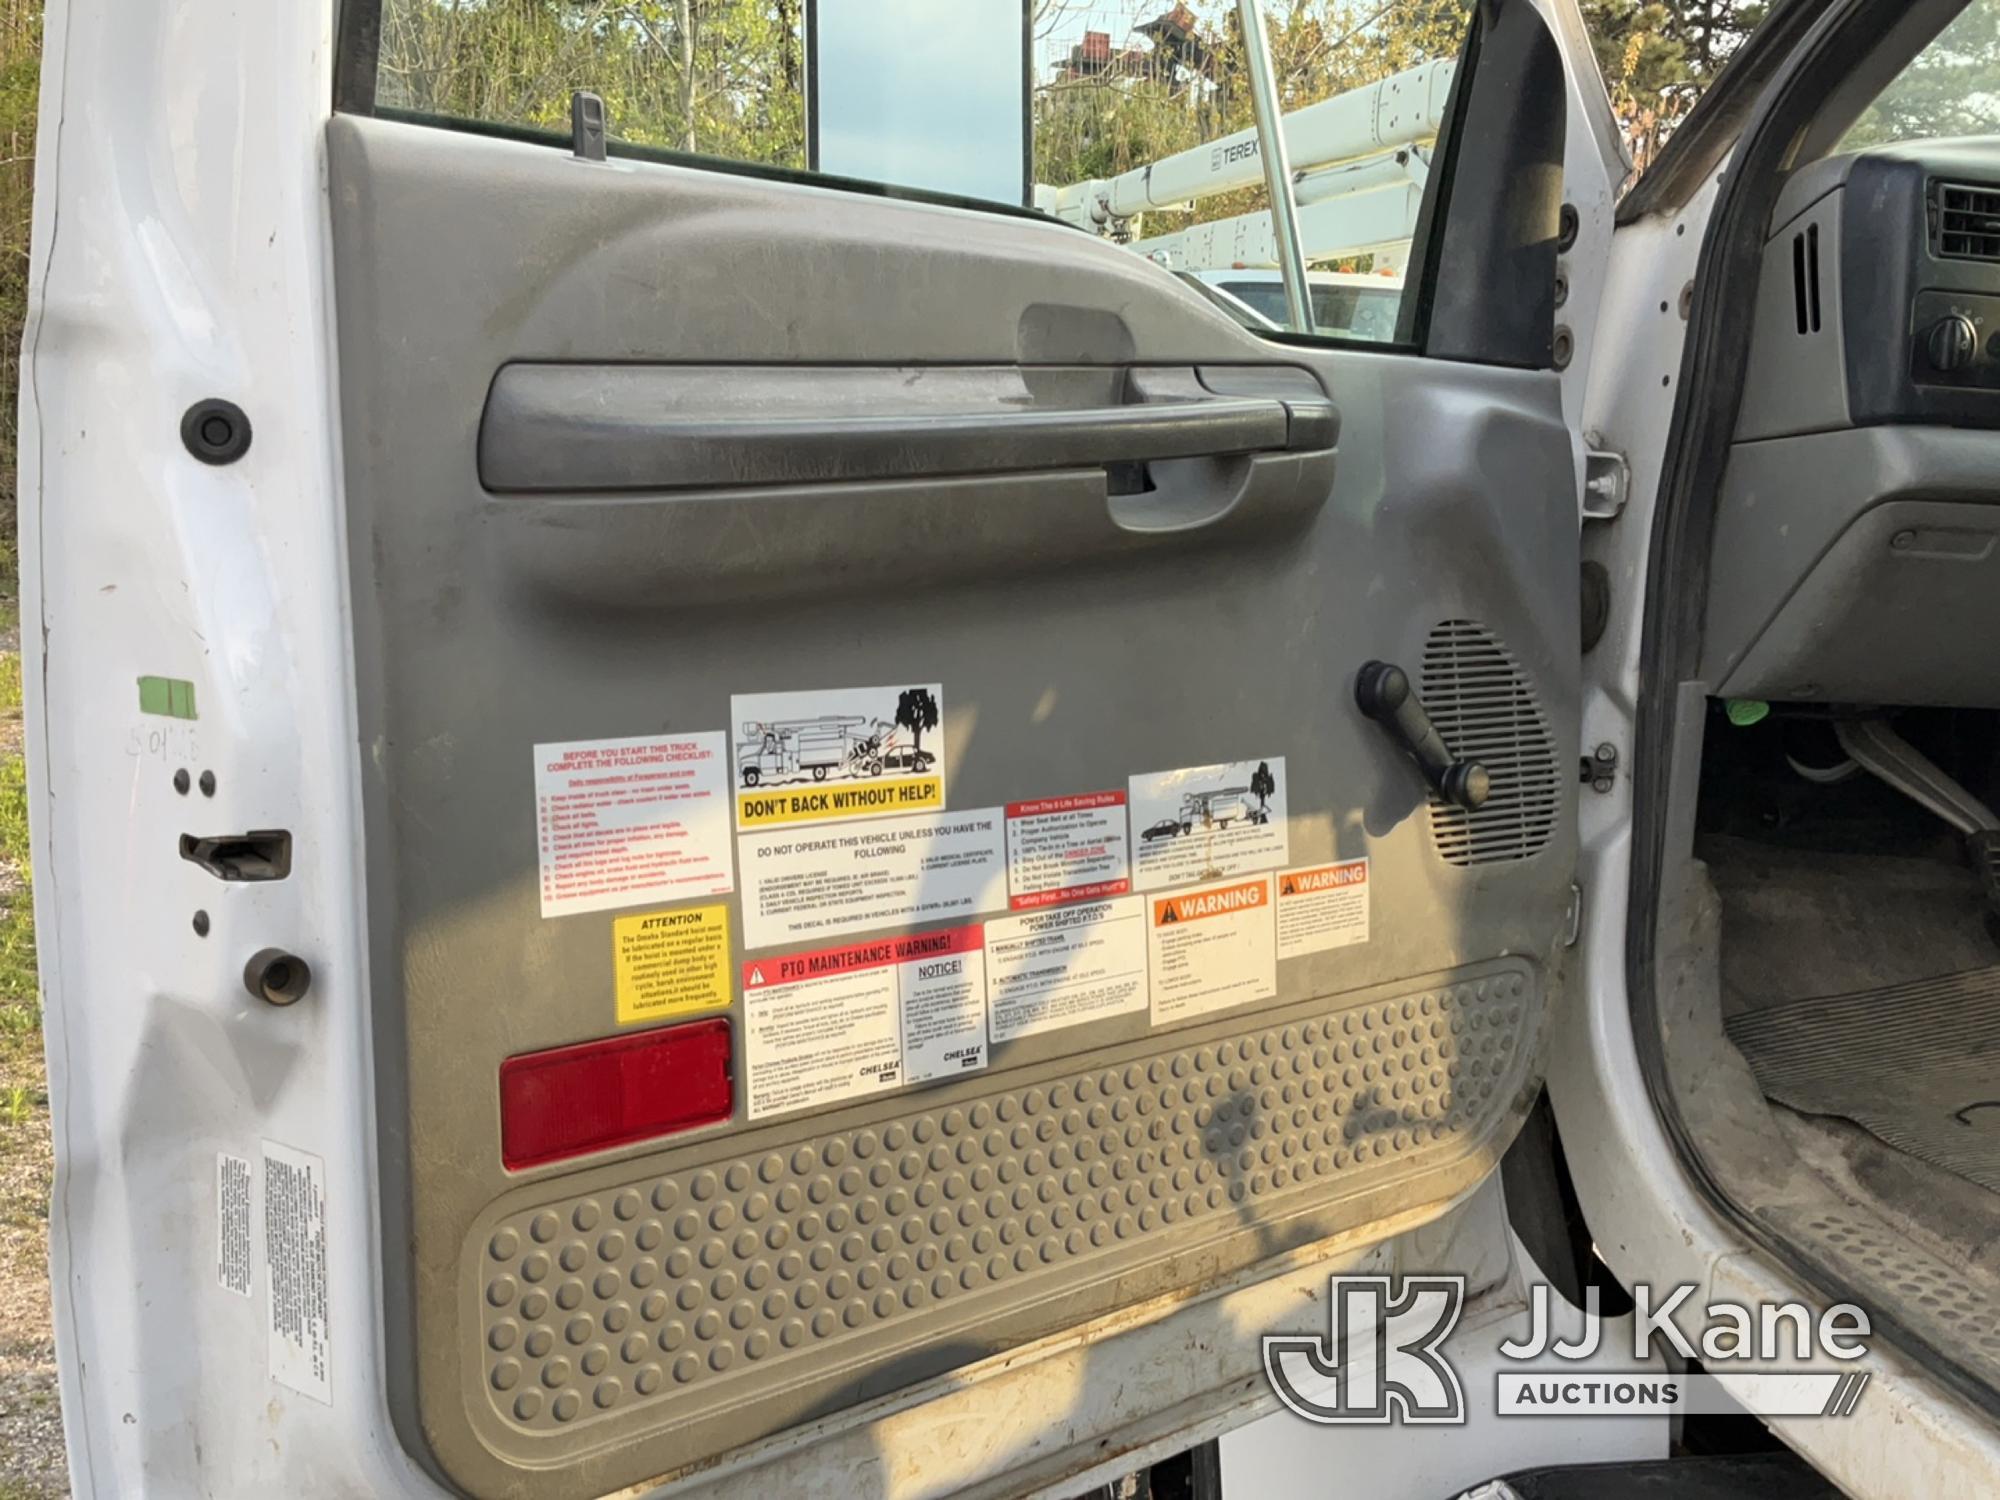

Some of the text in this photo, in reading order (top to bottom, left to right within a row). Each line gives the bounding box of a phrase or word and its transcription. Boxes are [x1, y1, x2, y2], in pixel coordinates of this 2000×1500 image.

[1224, 138, 1259, 164] TEREX
[547, 750, 713, 772] COMPLETE THE FOLLOWING CHECKLIST:
[563, 742, 697, 760] BEFORE YOU START THIS TRUCK
[744, 784, 935, 817] DON'T BACK WITHOUT HELP!
[758, 821, 992, 858] DO NOT OPERATE THIS VEHICLE UNLESS YOU HAVE THE
[854, 844, 905, 859] FOLLOWING
[1297, 865, 1363, 892] WARNING
[1180, 886, 1260, 918] WARNING
[641, 913, 703, 929] ATTENTION
[1020, 904, 1112, 926] POWER TAKE OFF OPERATION
[1030, 921, 1054, 932] POWER
[1056, 916, 1081, 927] SHIFTED
[781, 935, 951, 978] PTO MAINTENANCE WARNING!
[919, 960, 962, 979] NOTICE!
[944, 1046, 981, 1061] CHELSEA
[860, 1060, 900, 1076] CHELSEA
